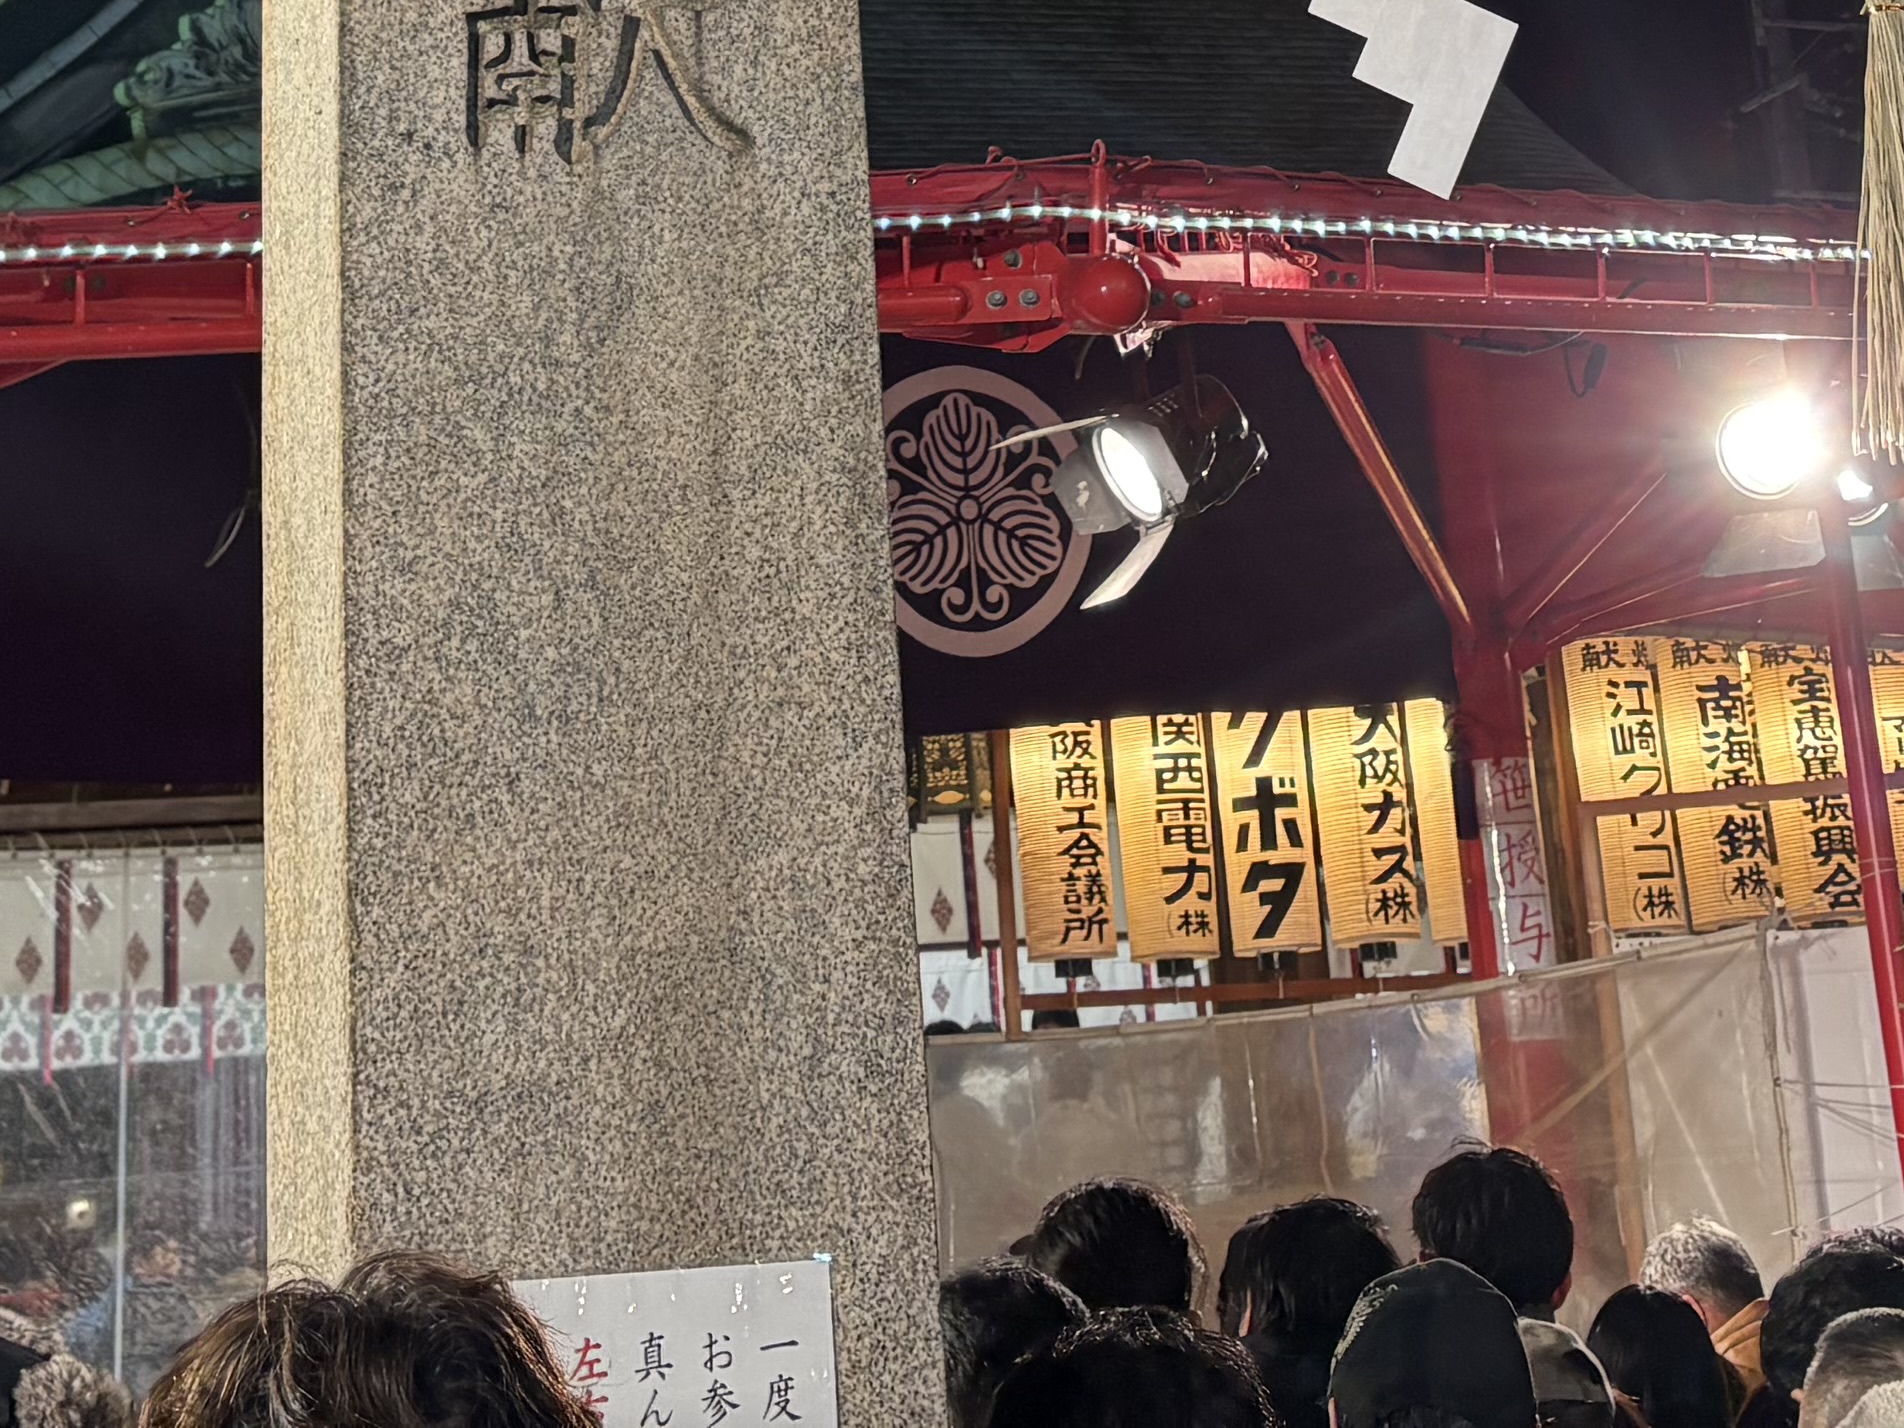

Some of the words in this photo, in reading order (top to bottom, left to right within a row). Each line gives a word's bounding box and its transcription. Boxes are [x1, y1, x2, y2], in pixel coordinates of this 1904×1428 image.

[1047, 721, 1109, 944] 阪商工会議所
[1152, 714, 1213, 938] 関西電力(株
[634, 1331, 673, 1427] 真ん
[758, 1336, 803, 1422] 一度
